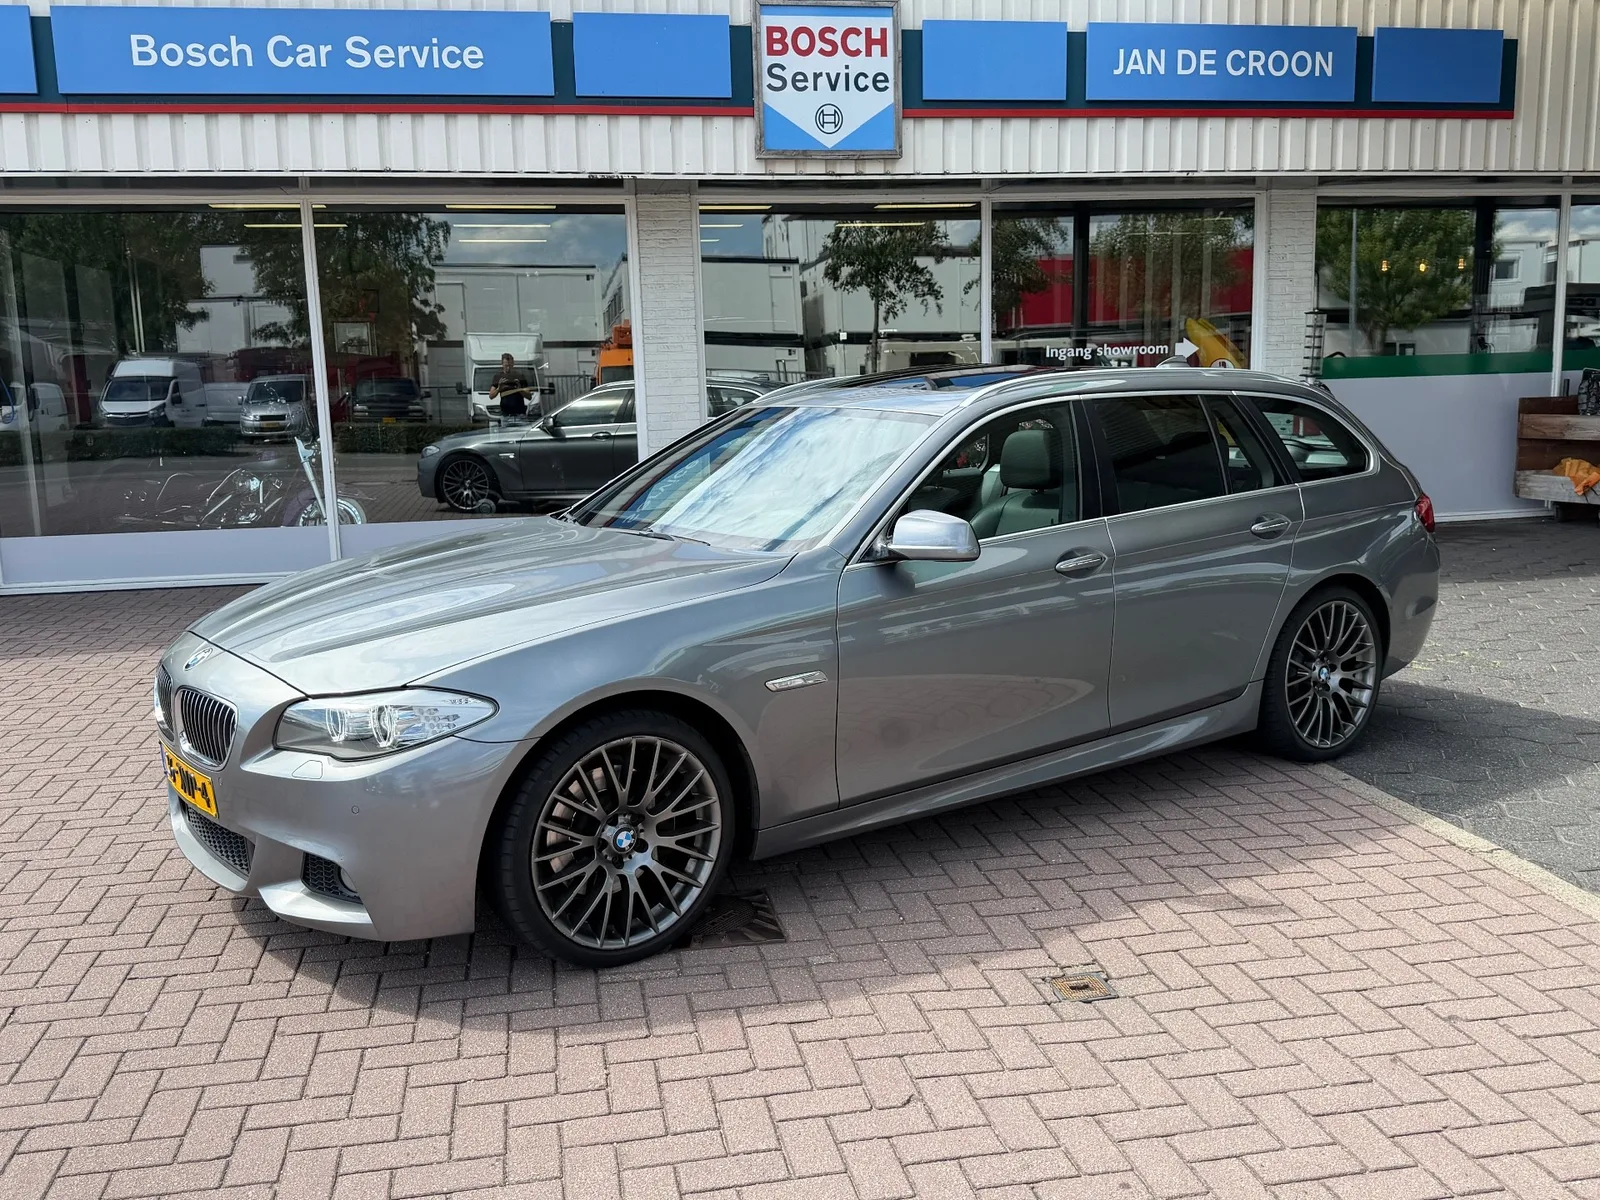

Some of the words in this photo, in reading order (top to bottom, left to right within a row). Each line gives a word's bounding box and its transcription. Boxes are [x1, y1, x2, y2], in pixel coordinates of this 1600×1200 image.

[130, 34, 254, 67] Bosch
[266, 34, 332, 68] Car
[345, 35, 485, 69] Service
[765, 25, 888, 58] BOSCH
[766, 62, 890, 93] Service
[1113, 48, 1166, 75] JAN
[1176, 49, 1217, 76] DE
[1225, 49, 1333, 77] CROON
[1045, 345, 1092, 361] Ingang
[1096, 343, 1169, 357] showroom
